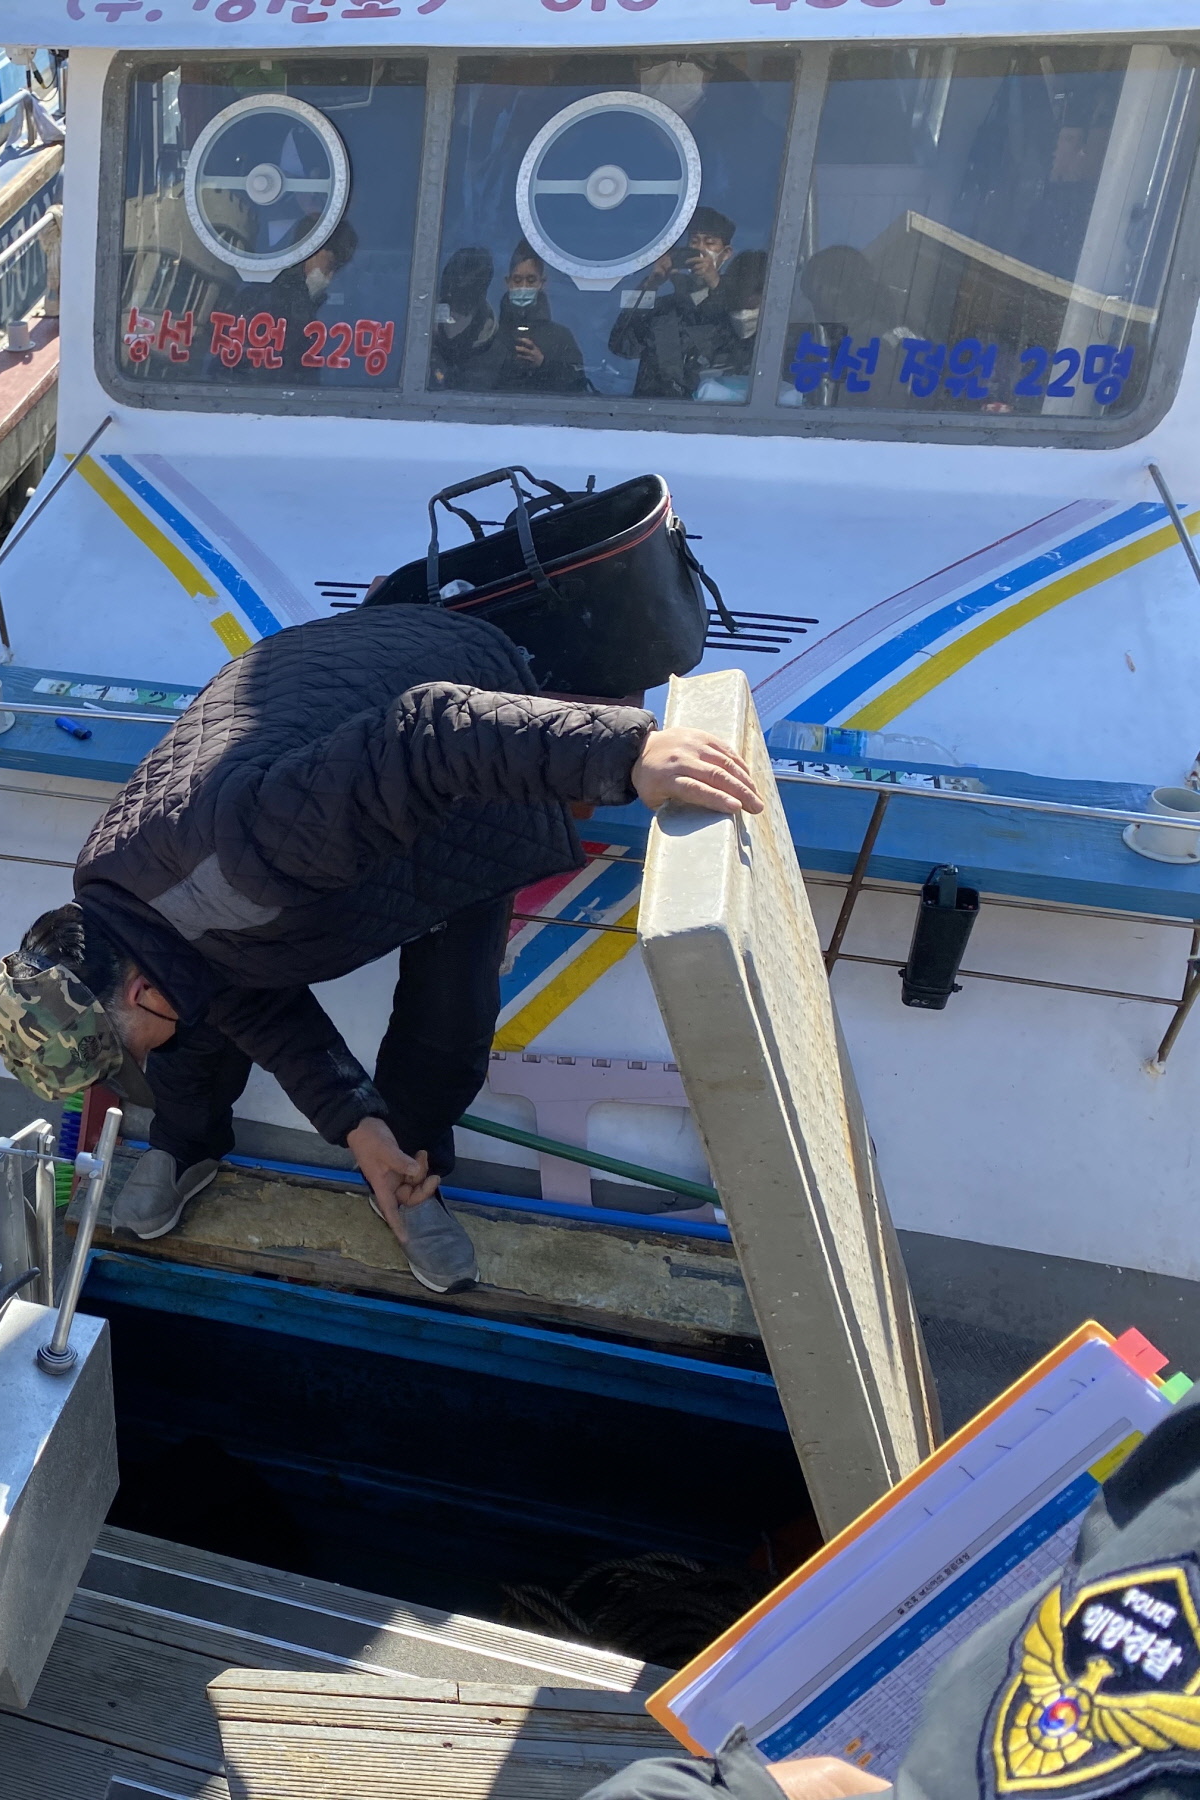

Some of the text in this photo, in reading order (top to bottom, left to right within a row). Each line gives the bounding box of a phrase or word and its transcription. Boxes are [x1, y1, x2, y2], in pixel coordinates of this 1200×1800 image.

[123, 306, 395, 376] 승선 정원 22명
[790, 331, 1135, 406] 승선 정원 22명
[1082, 1603, 1184, 1681] 해양경찰
[1122, 1587, 1178, 1629] POLICE
